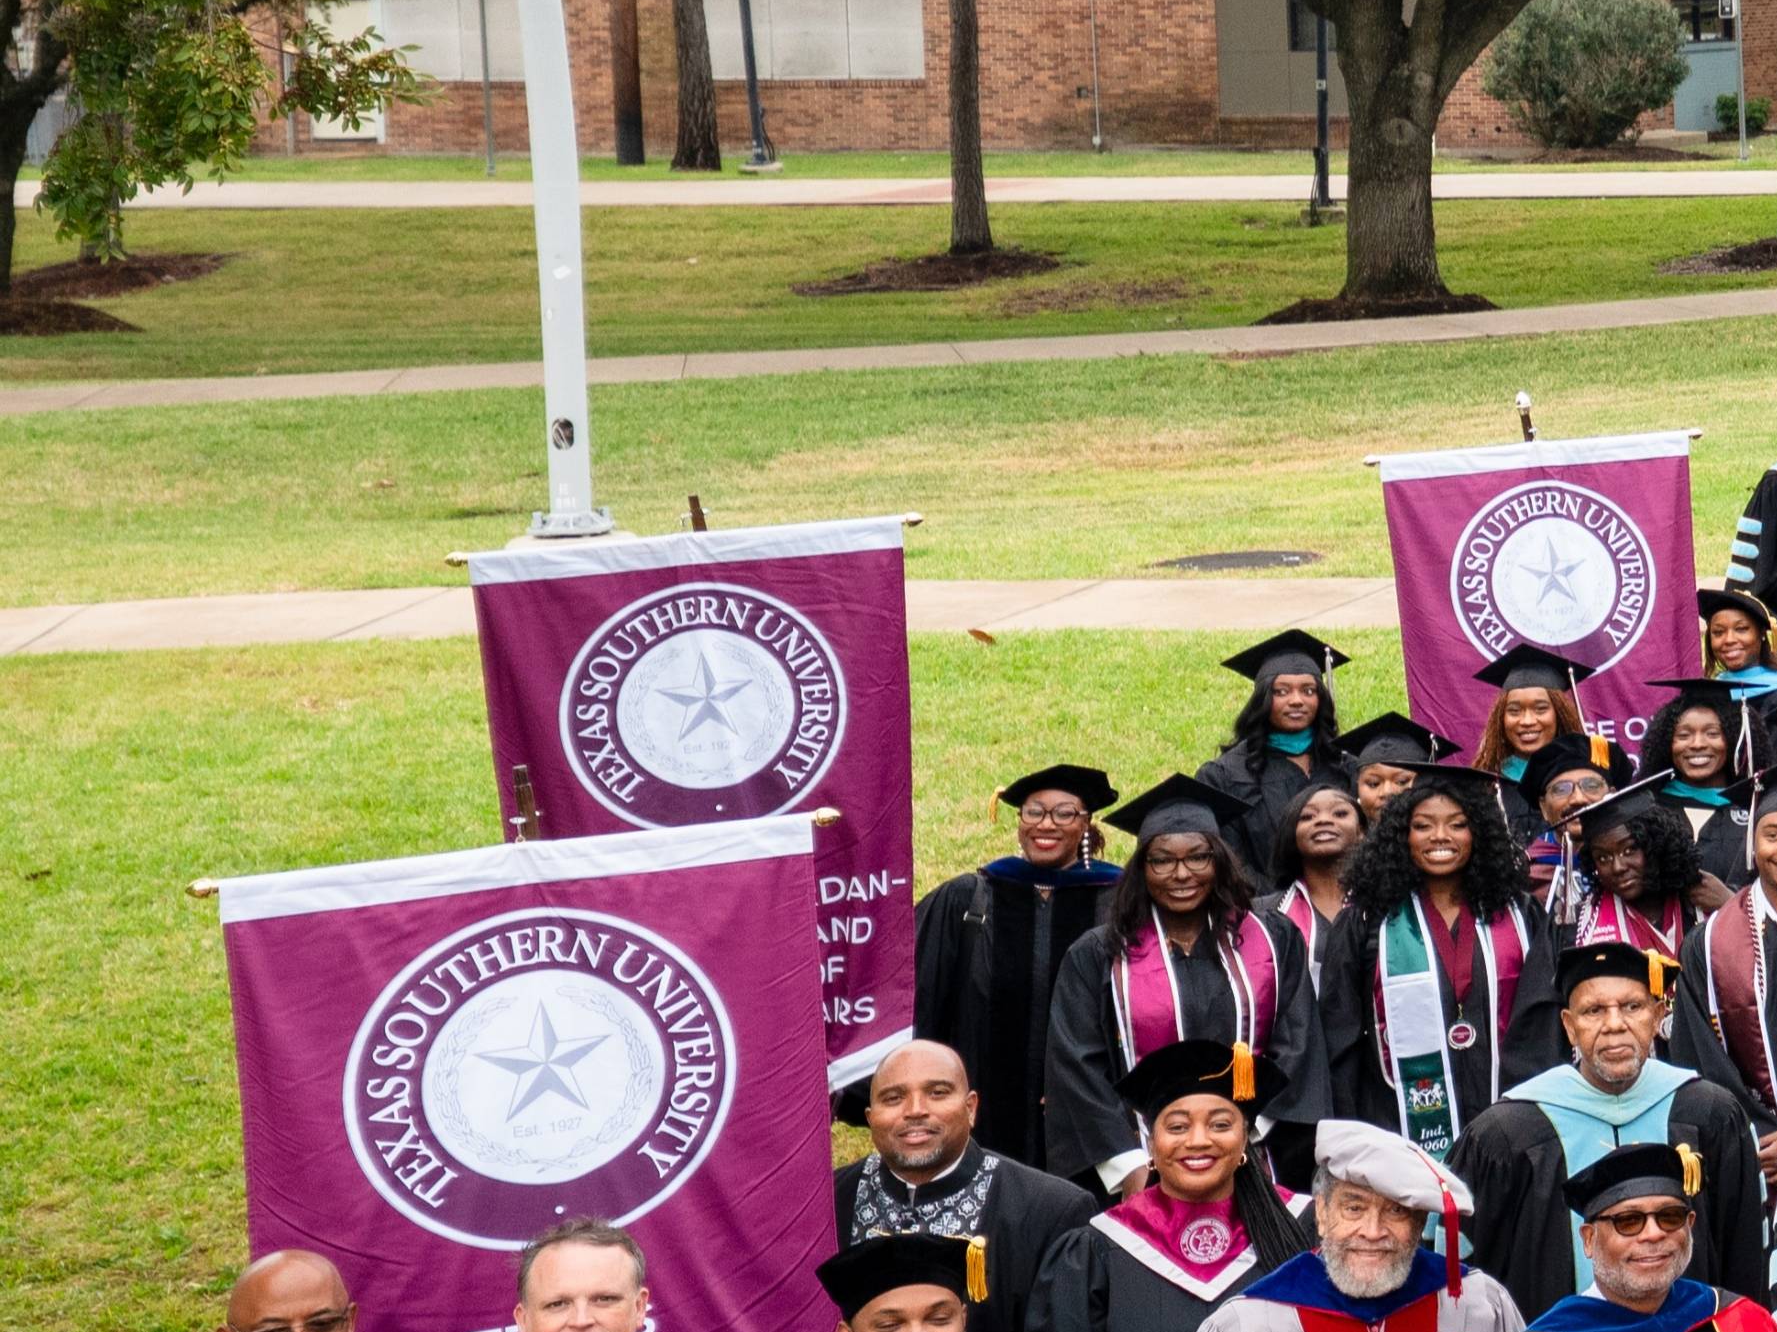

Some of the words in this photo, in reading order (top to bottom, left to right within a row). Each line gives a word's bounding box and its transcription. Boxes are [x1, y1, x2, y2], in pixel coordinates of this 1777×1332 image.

[1466, 492, 1582, 573] SOUTHERN
[1584, 502, 1645, 647] UNIVERSITY
[580, 596, 750, 701] SOUTHERN
[1463, 576, 1514, 655] TEXAS
[754, 609, 834, 789] UNIVERSITY
[576, 704, 647, 803] TEXAS
[818, 870, 906, 906] DAN-
[374, 926, 611, 1074] SOUTHERN
[613, 941, 717, 1180] UNIVERSITY
[368, 1078, 458, 1208] TEXAS
[512, 1124, 544, 1139] Est.
[550, 1116, 583, 1134] 1927
[1420, 1125, 1445, 1139] Ind.
[1421, 1137, 1449, 1151] 960
